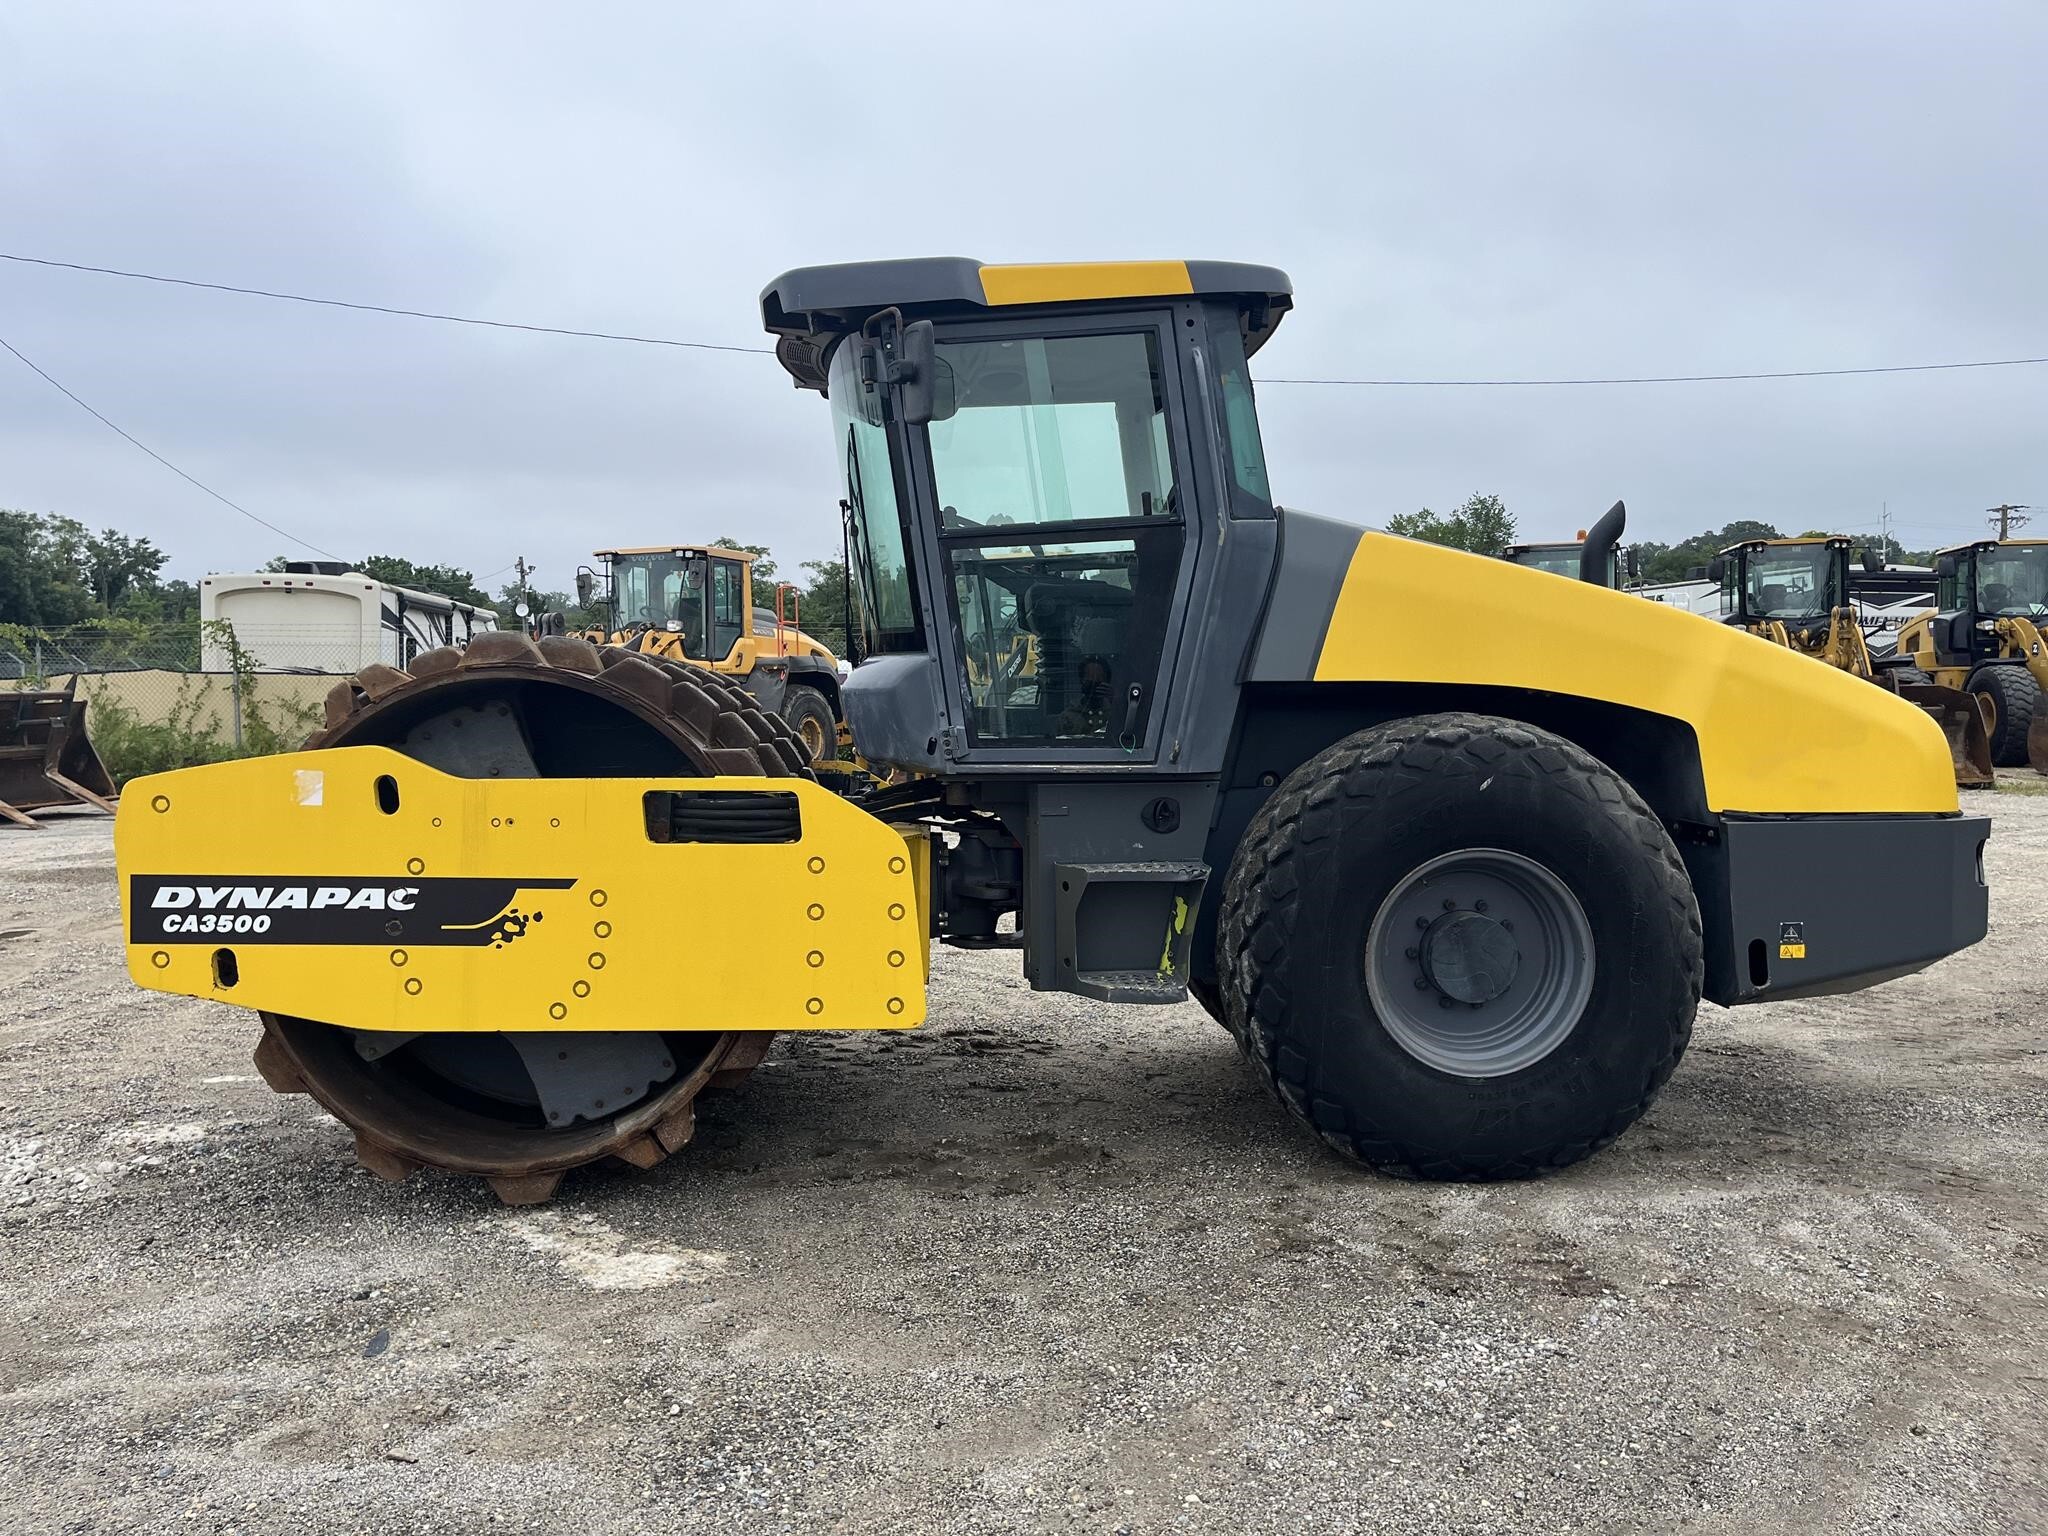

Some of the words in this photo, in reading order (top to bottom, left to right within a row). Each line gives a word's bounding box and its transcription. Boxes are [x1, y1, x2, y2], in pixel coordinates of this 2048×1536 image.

[631, 554, 665, 562] VOLVO
[151, 886, 420, 911] DYNAPAC
[162, 914, 272, 933] CA3500
